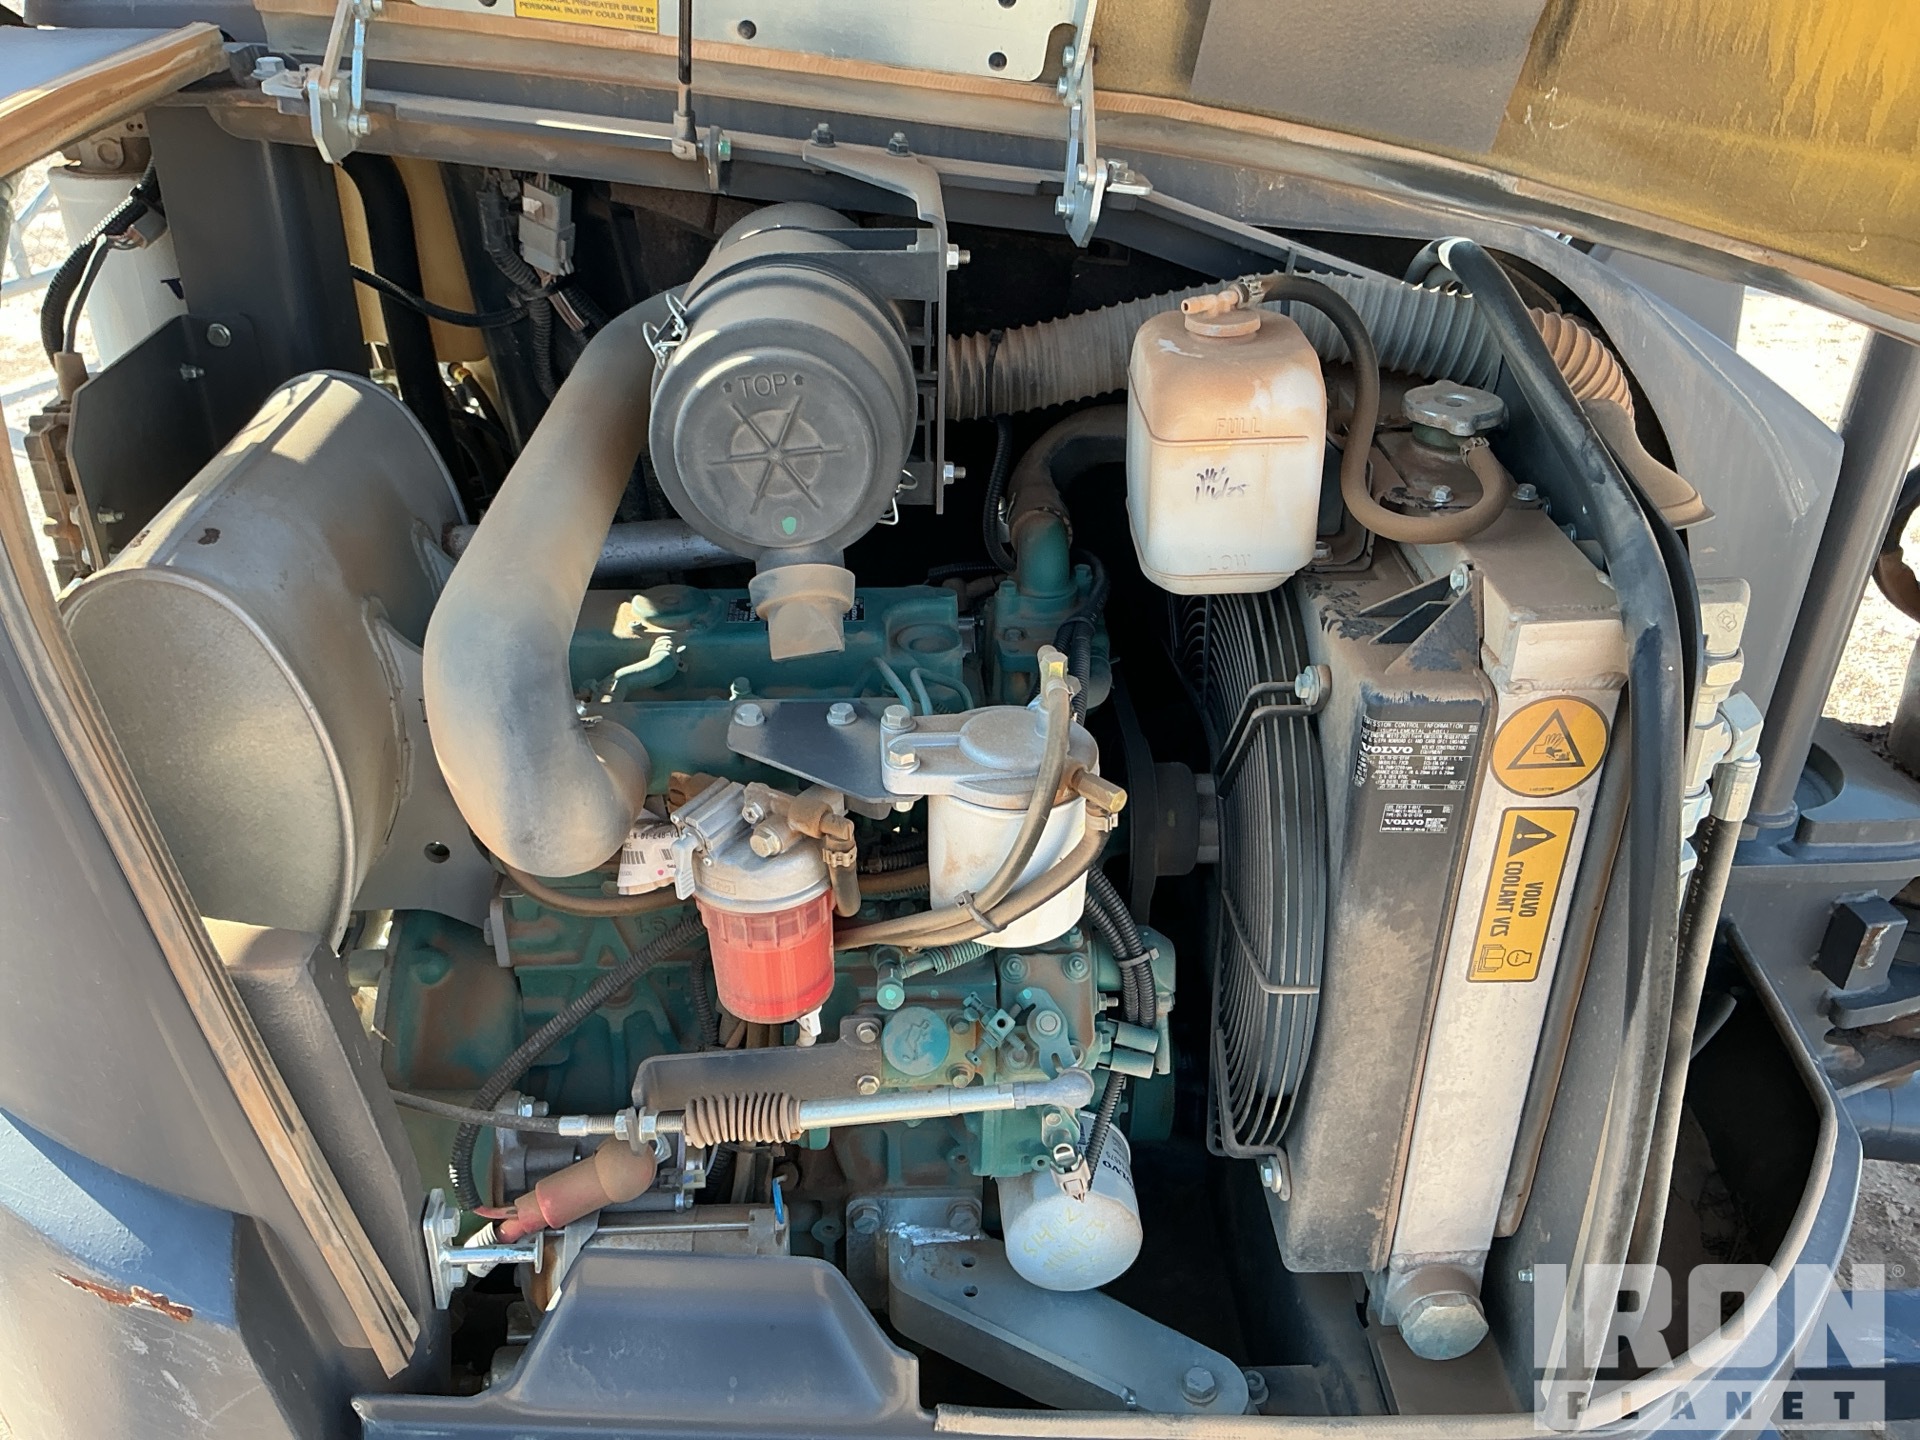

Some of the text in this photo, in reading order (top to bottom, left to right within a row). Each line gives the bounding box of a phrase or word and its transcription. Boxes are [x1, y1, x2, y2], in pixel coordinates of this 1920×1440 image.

[519, 2, 563, 13] PERSONAL
[564, 7, 593, 16] INJURY
[595, 10, 624, 19] COULD
[625, 13, 656, 24] RESULT
[736, 372, 788, 399] TOP
[1215, 416, 1261, 436] FULL
[1208, 553, 1251, 571] LOW
[1424, 722, 1464, 730] INFORMATION
[1361, 742, 1413, 754] VOLVO
[1384, 818, 1425, 826] VOLVO
[1489, 861, 1525, 938] COOLANT VCS
[1518, 881, 1545, 918] VOLVO
